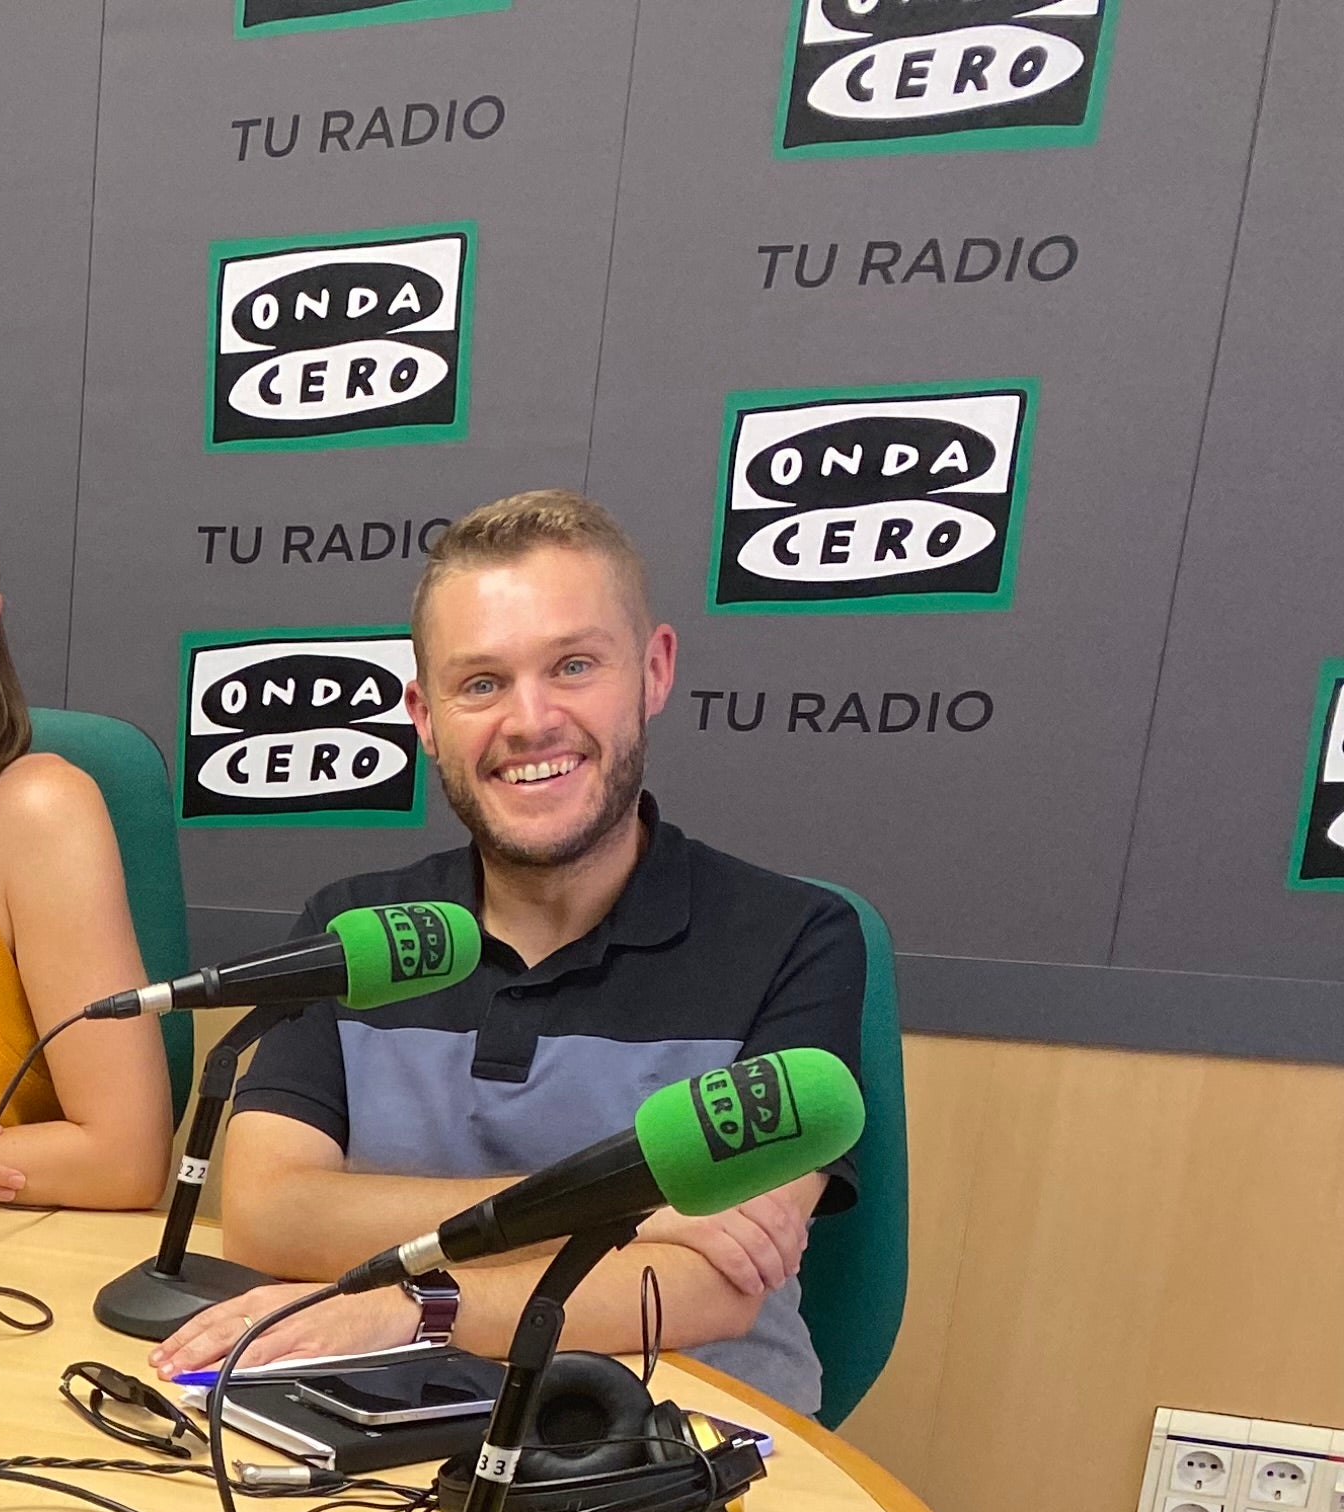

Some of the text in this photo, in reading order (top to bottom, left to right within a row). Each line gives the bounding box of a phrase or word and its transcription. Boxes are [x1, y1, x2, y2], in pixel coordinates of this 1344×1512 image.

[846, 45, 1048, 102] CERO
[231, 95, 505, 161] TU RADIO
[757, 234, 1079, 288] TU RADIO
[252, 282, 421, 330] ONDA
[258, 357, 419, 405] CERO
[770, 440, 970, 486] ONDA
[197, 525, 262, 564] TU
[772, 519, 962, 566] CERO
[220, 676, 383, 713] ONDA
[689, 690, 994, 733] TU RADIO
[226, 744, 380, 784] CERO
[390, 911, 416, 967] CERO
[413, 907, 439, 963] ONDA
[185, 1165, 194, 1179] 2
[479, 1454, 506, 1475] 3 3
